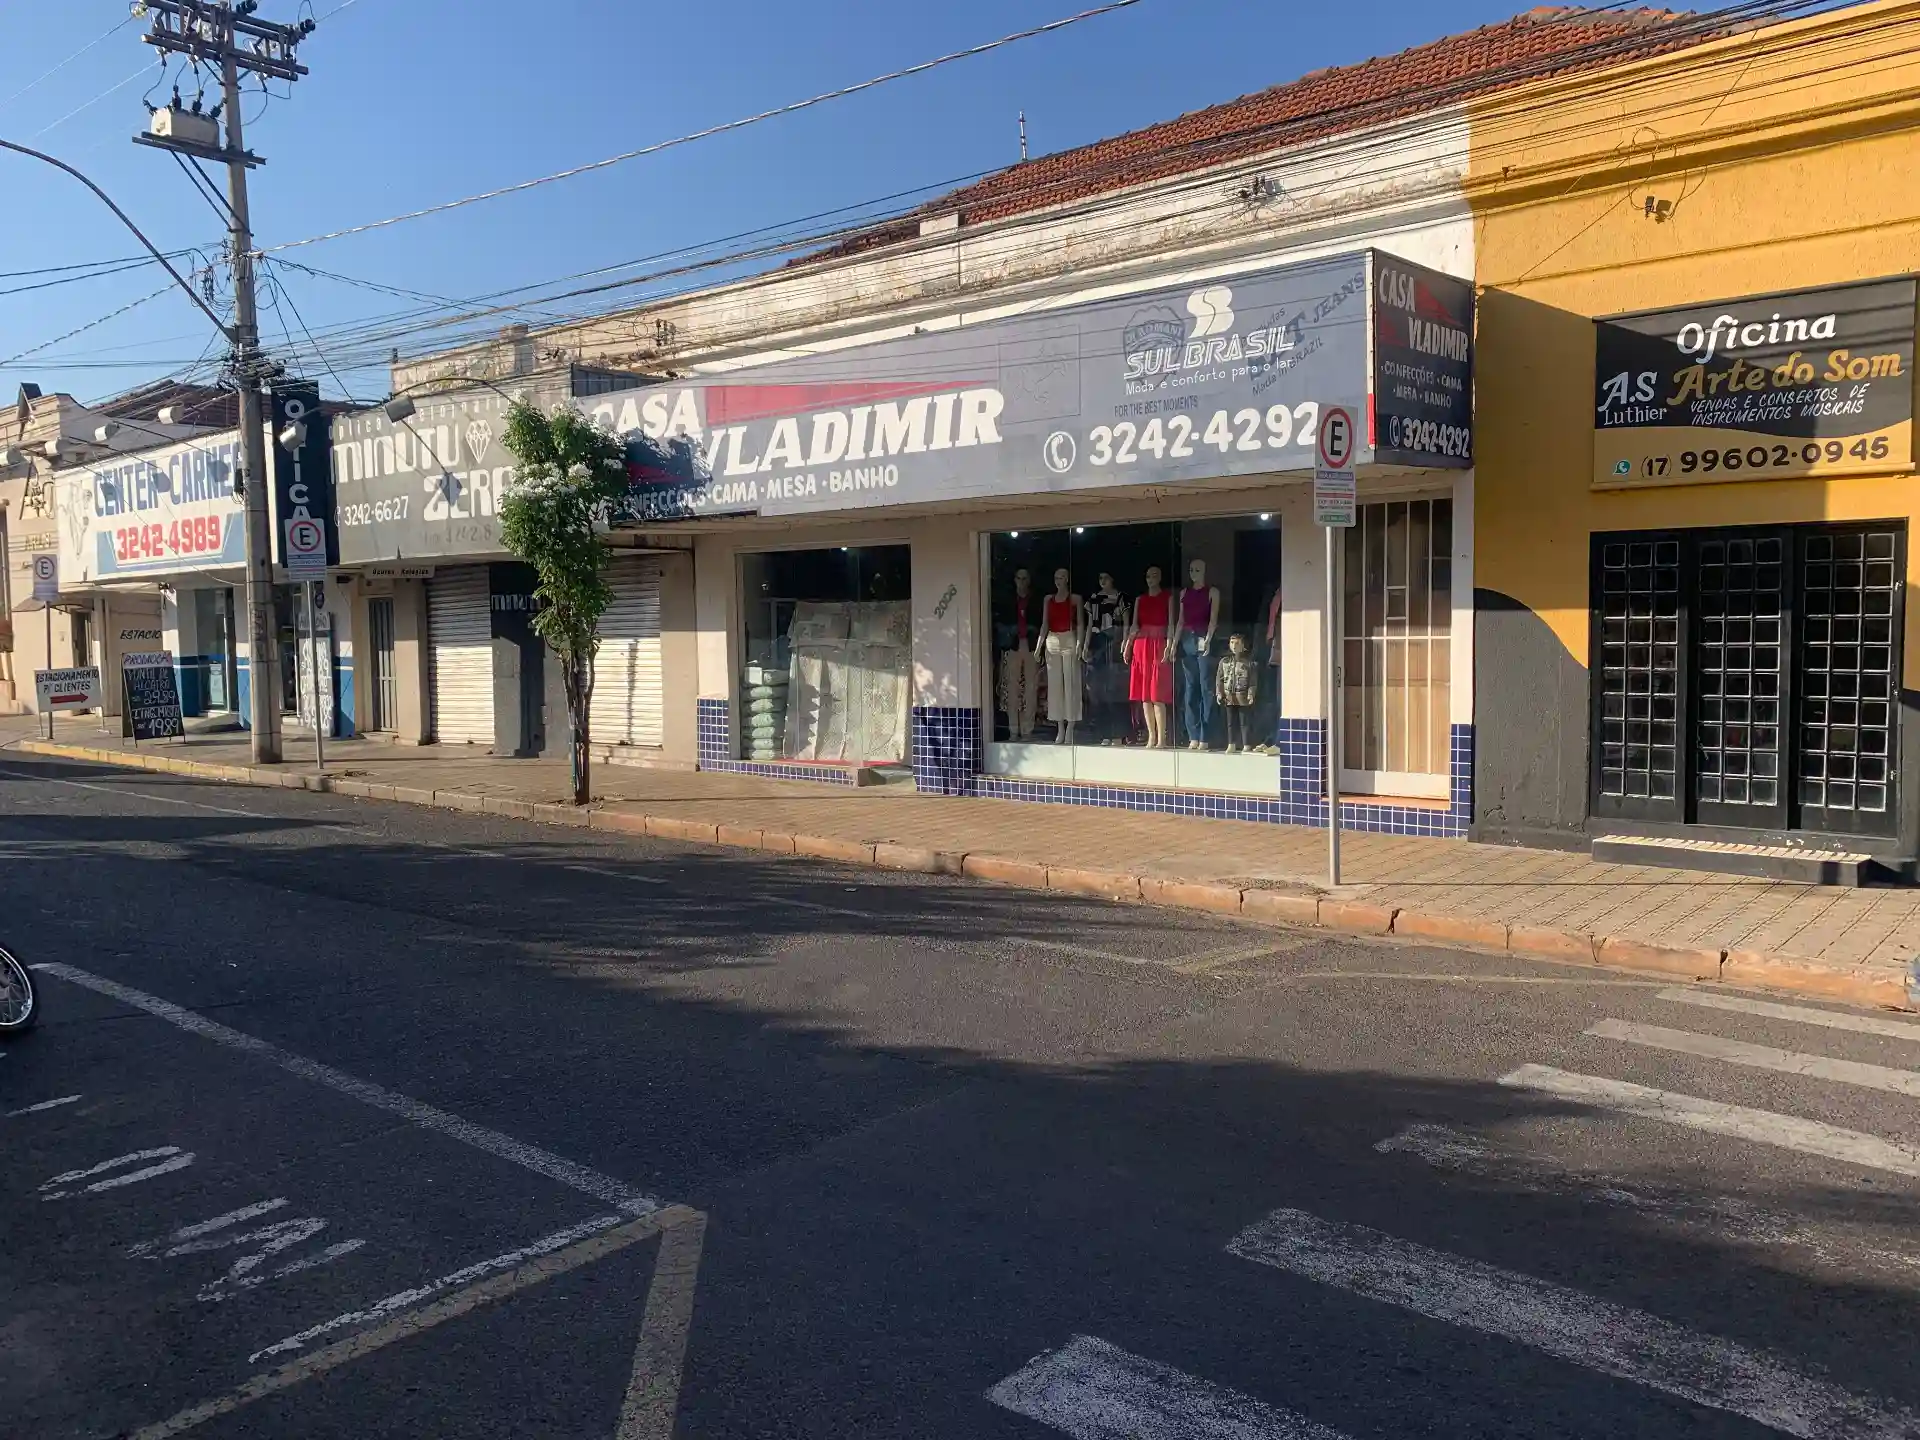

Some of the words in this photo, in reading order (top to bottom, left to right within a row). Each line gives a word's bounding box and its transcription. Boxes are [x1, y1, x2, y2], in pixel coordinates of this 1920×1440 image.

[1379, 268, 1416, 313] CASA
[1408, 316, 1468, 363] VLADIMIR
[1676, 313, 1836, 364] Oficina
[1126, 381, 1155, 396] Moda
[1160, 380, 1168, 389] e
[1172, 370, 1226, 388] conforto
[1232, 365, 1258, 382] para
[1263, 363, 1272, 372] o
[1276, 356, 1296, 371] lar
[1441, 374, 1462, 392] CAMA
[1666, 358, 1766, 406] Arte
[1772, 350, 1814, 388] do
[1823, 349, 1905, 382] Som
[590, 389, 701, 438] CASA
[1114, 405, 1128, 417] FOR
[1130, 402, 1143, 415] THE
[1144, 399, 1162, 413] BEST
[1163, 395, 1198, 411] MOMENTS
[1426, 391, 1452, 408] BANHO
[1691, 396, 1738, 413] VENDAS
[1743, 394, 1752, 409] E
[1758, 387, 1838, 408] CONSERTOS
[1849, 382, 1871, 398] DE
[1691, 406, 1792, 426] INSTRUMENTOS
[1800, 399, 1865, 417] MUSICAIS
[1603, 405, 1668, 426] Luthier
[697, 388, 1004, 477] VLADIMIR
[1089, 401, 1319, 466] 3242-4292
[1330, 420, 1343, 456] E
[1640, 456, 1672, 478] (17)
[713, 480, 758, 505] CAMA
[767, 473, 817, 499] MESA
[830, 464, 899, 493] BANHO
[344, 495, 409, 527] 3242-6627
[117, 515, 221, 561] 3242-4989
[299, 527, 311, 546] E
[40, 561, 49, 575] E
[36, 669, 99, 683] ESTACIONAMENTO
[54, 681, 91, 693] CLIENTES
